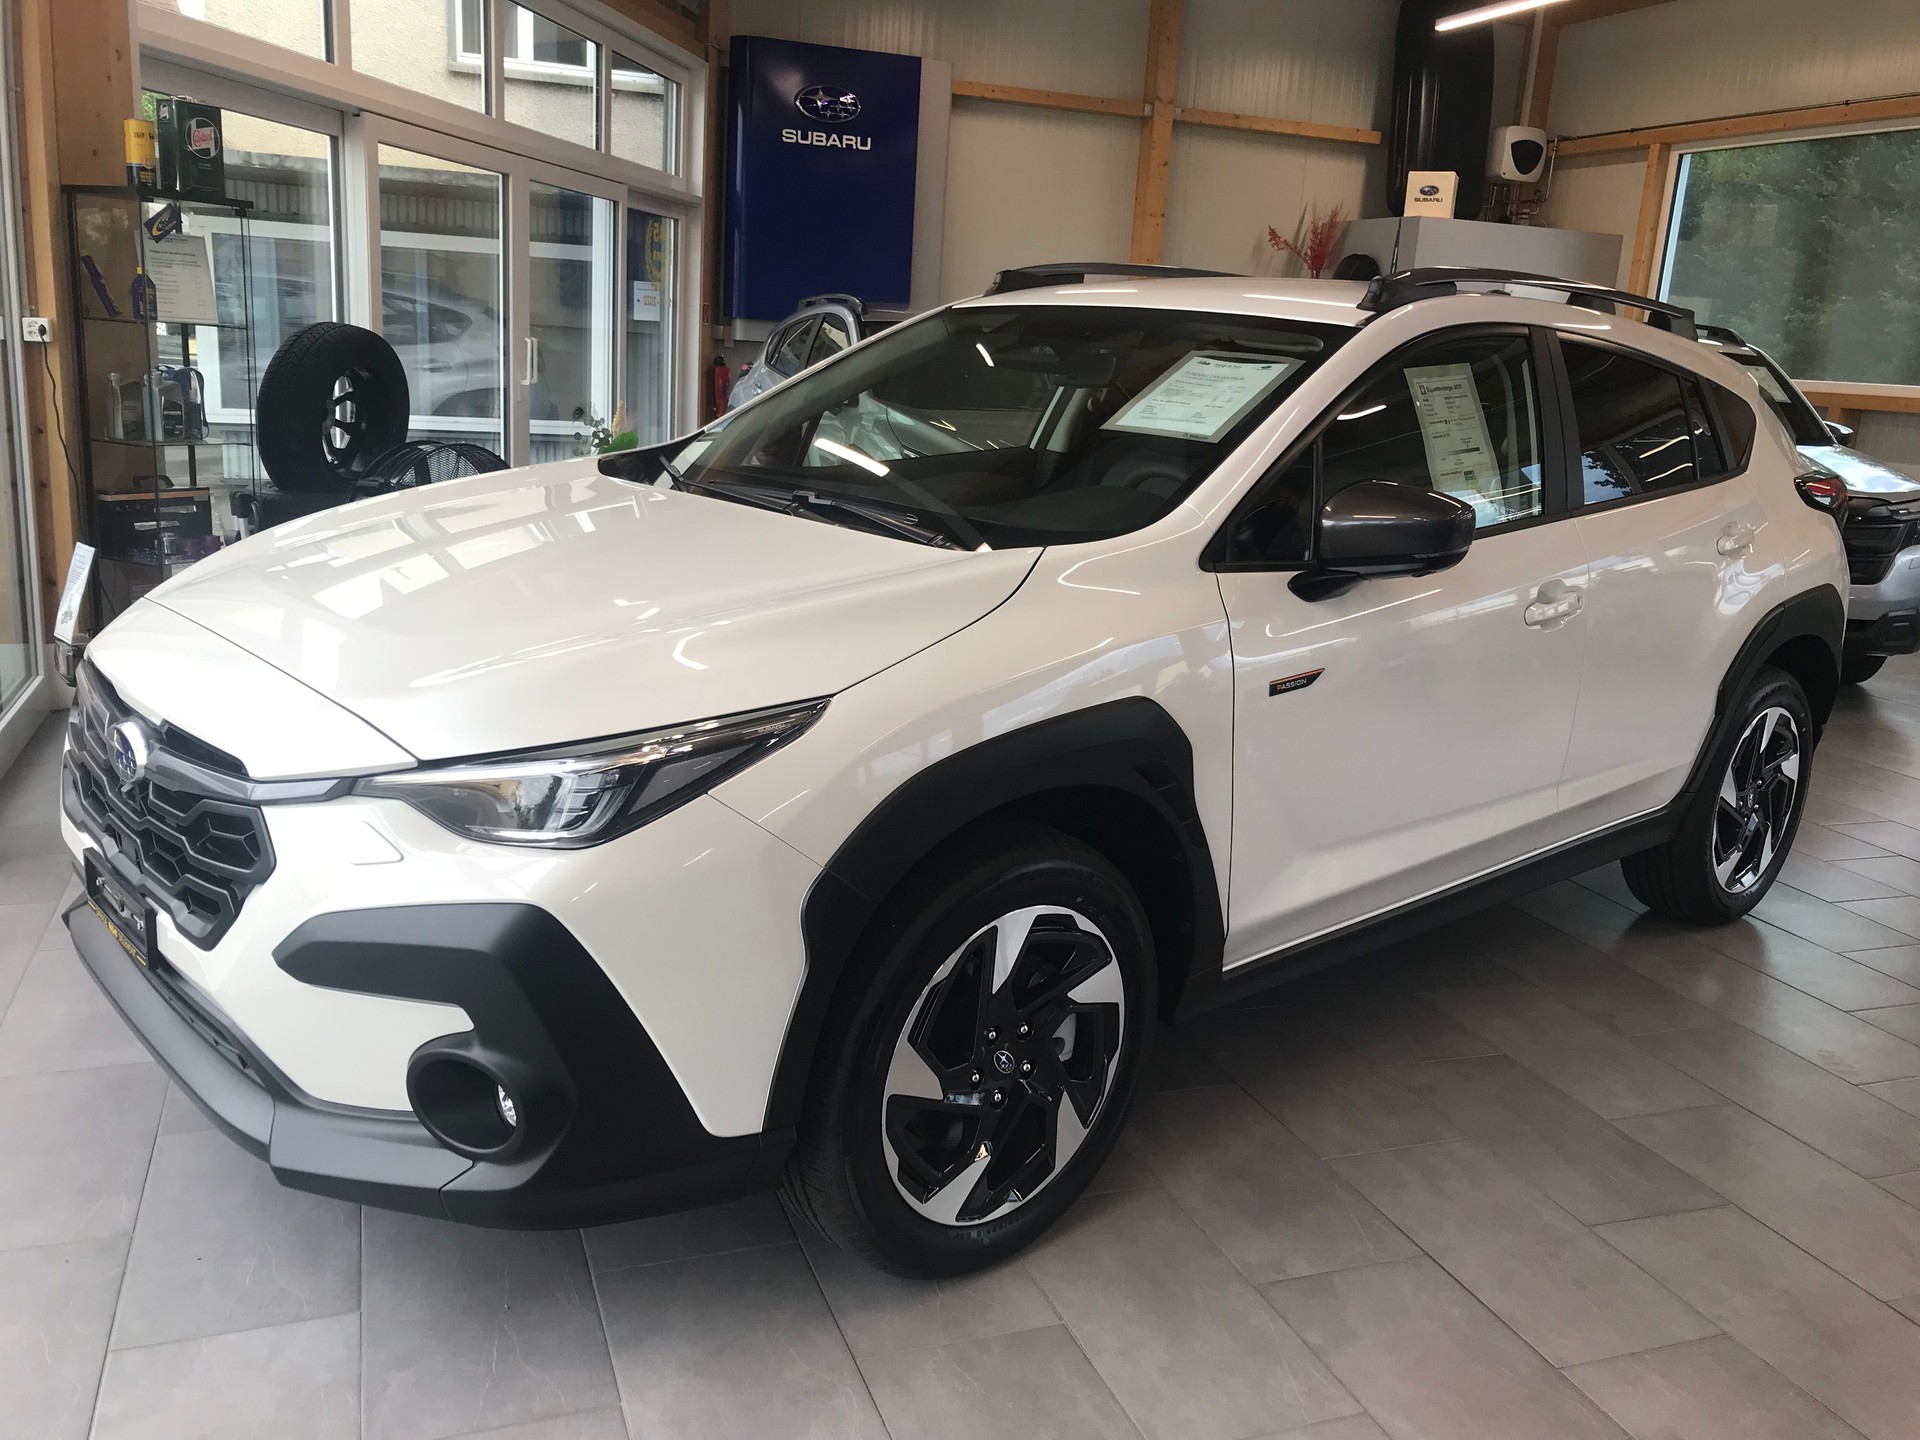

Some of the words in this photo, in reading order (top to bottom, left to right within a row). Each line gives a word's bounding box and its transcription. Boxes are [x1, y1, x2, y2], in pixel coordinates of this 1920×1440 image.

[192, 129, 213, 147] Castrol
[781, 128, 872, 151] SUBARU
[1276, 678, 1307, 691] PASSION
